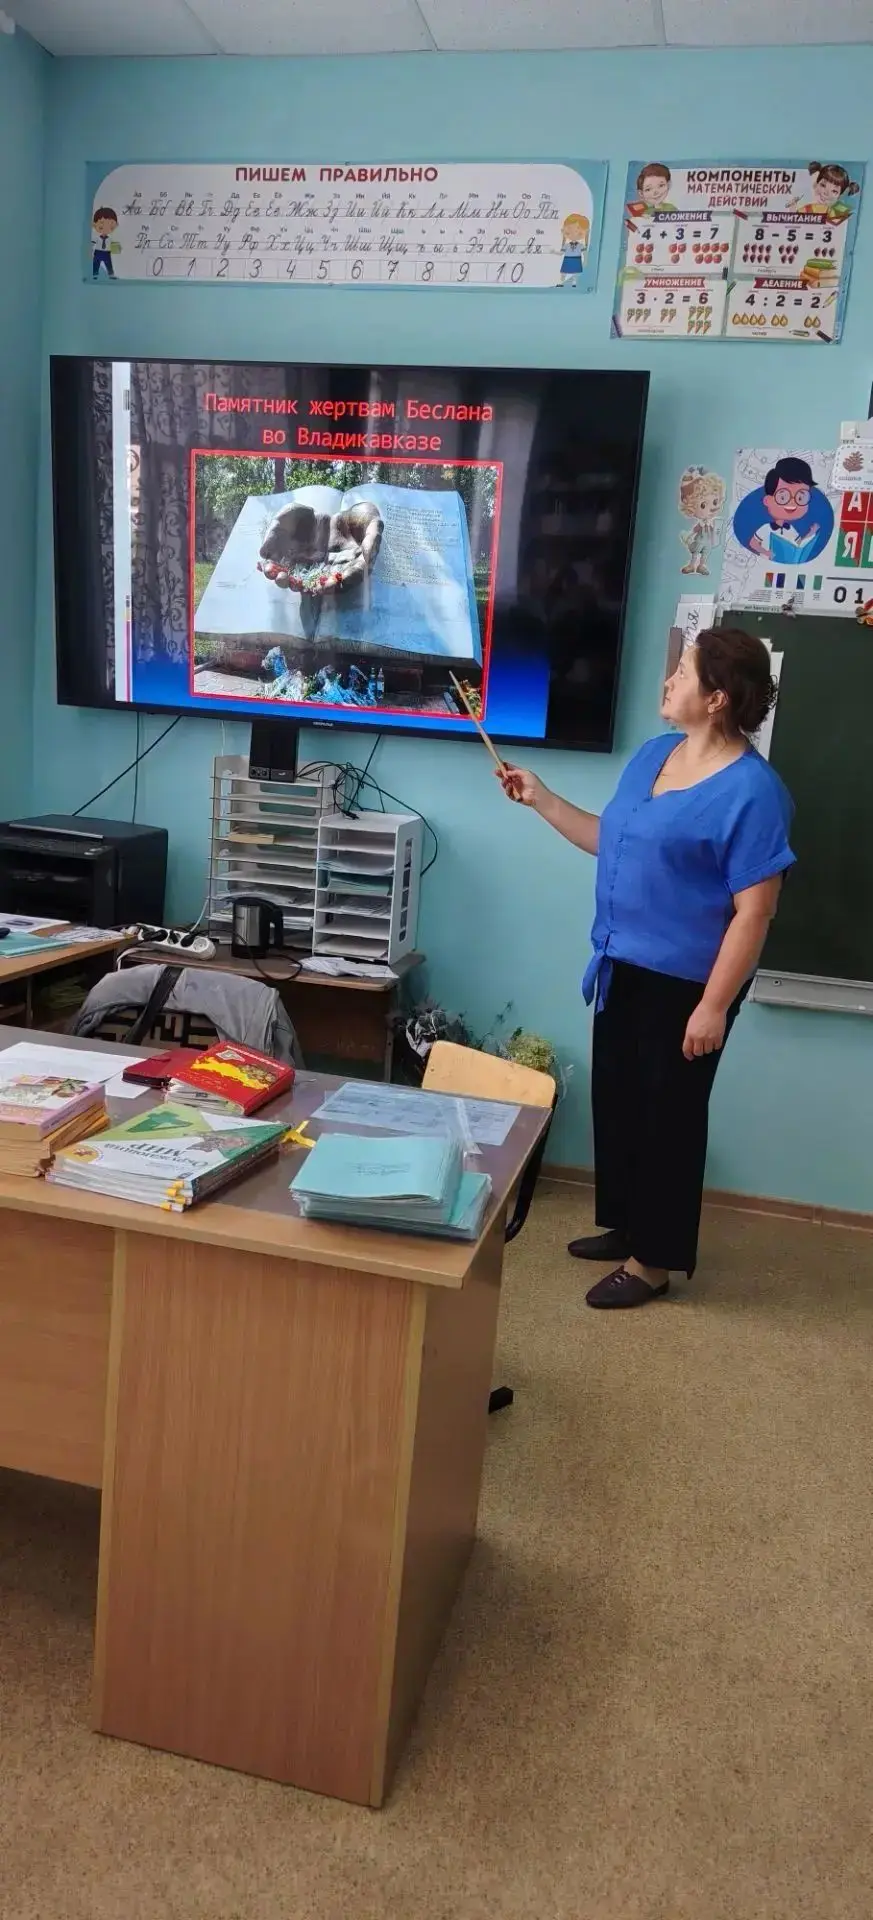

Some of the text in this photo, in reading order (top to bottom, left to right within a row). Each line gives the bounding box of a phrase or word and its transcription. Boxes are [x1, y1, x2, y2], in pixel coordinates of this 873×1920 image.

[235, 167, 438, 182] ПИШЕМ ПРАВИЛЬНО
[687, 170, 796, 183] КОМПОНЕНТЫ
[687, 183, 792, 195] МАТЕМАТИЧЕСКИХ
[707, 195, 768, 208] ДЕЙСТВИЙ
[122, 199, 142, 216] Аа
[149, 199, 172, 216] Бб
[174, 199, 195, 217] Вв
[220, 199, 241, 223] Дд
[286, 201, 319, 217] Жж
[346, 200, 366, 217] Ии
[448, 201, 480, 219] Мм
[485, 201, 510, 219] Нн
[513, 201, 531, 219] Оо
[533, 201, 560, 219] Пп
[658, 211, 708, 222] СЛОЖЕНИЕ
[766, 213, 823, 224] ВЫЧИТАНИЕ
[641, 227, 719, 241] 4 + 3 = 7
[755, 228, 765, 241] 8
[787, 229, 797, 242] 5
[805, 232, 814, 241] =
[822, 230, 832, 243] 3
[489, 236, 516, 254] Юю
[152, 256, 524, 283] 0 1 2 3 4 5 6 7 8 9 10
[646, 277, 703, 287] УМНОЖЕНИЕ
[762, 278, 803, 289] ДЕЛЕНИЕ
[636, 292, 646, 305] 3
[664, 292, 675, 305] 2
[682, 294, 691, 303] =
[698, 292, 709, 304] 6
[745, 294, 821, 309] 4 : 2 = 2
[205, 393, 494, 422] Памятник жертвам Беслана
[262, 427, 442, 451] во Владикавказе
[847, 491, 863, 513] А
[841, 531, 858, 559] Я
[833, 585, 864, 605] 0 1
[103, 1143, 209, 1168] Окружающий
